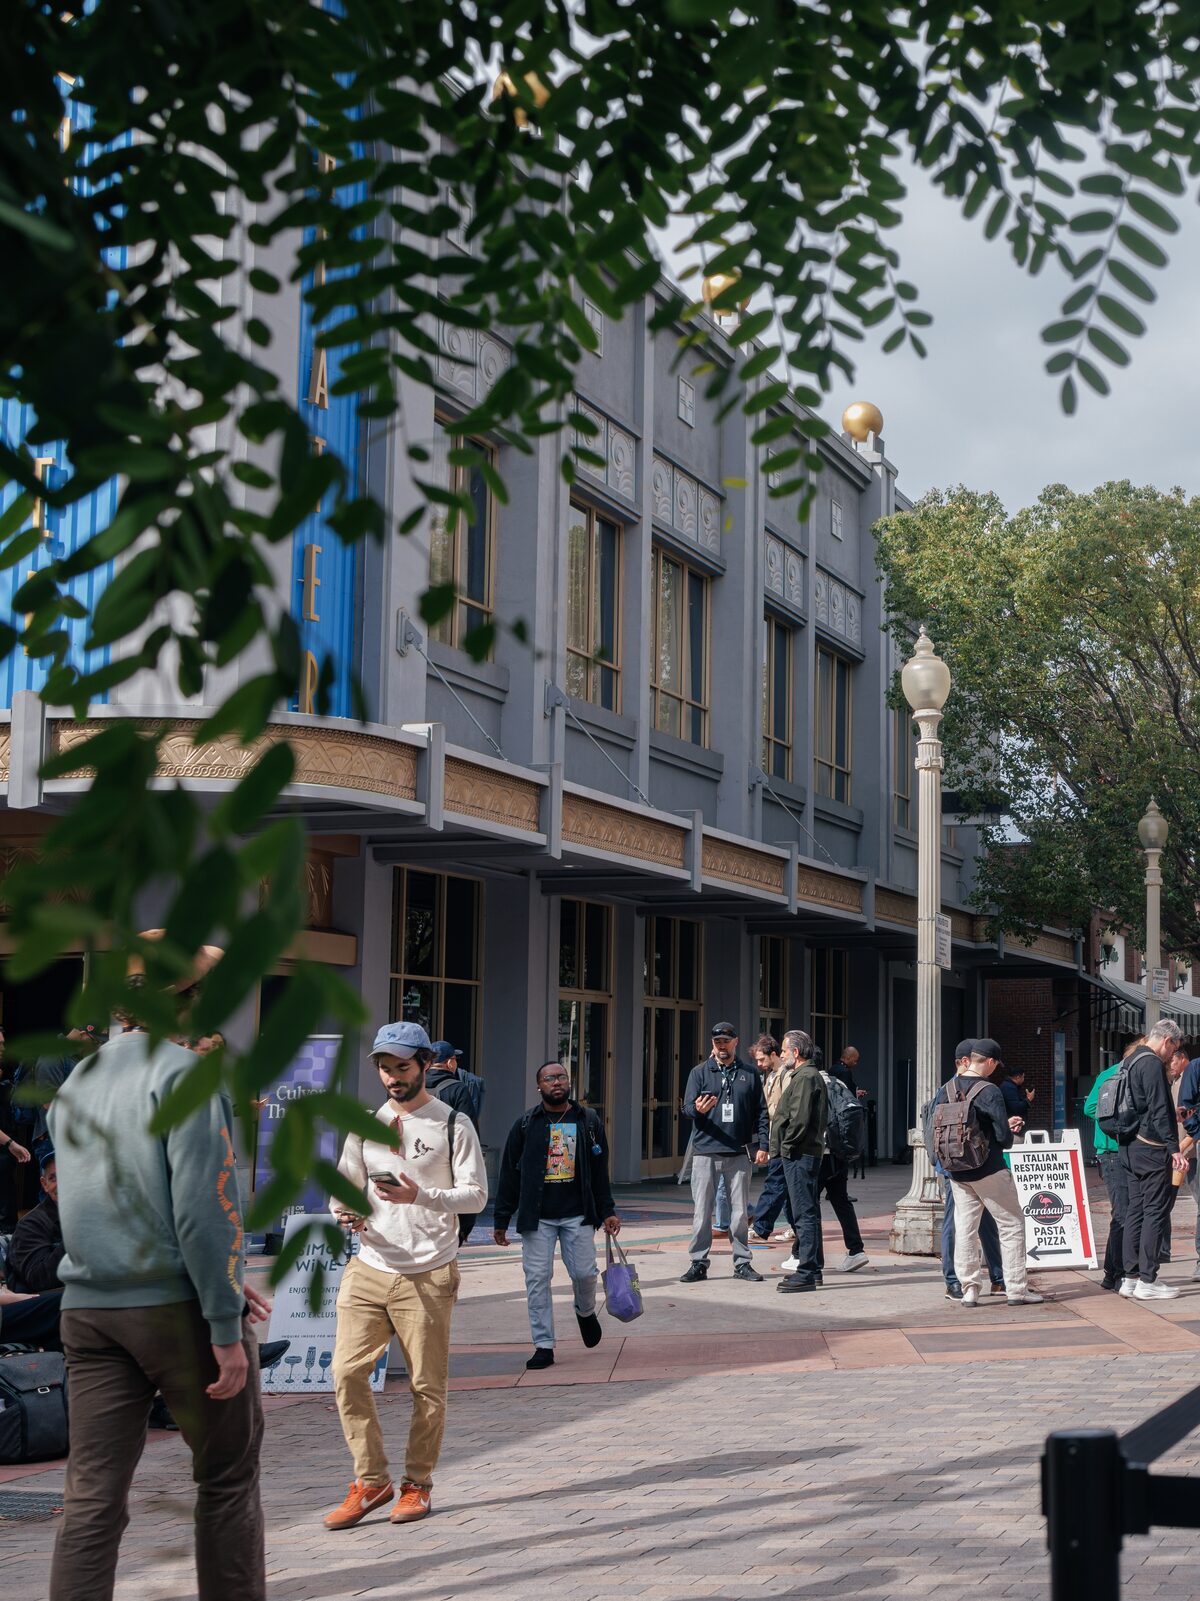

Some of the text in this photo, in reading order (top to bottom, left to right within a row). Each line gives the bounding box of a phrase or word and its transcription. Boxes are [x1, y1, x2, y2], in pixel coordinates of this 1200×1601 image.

[1023, 1153, 1058, 1163] ITALIAN
[1014, 1162, 1070, 1173] RESTAURANT
[1016, 1172, 1070, 1183] HAPPY HOUR
[1030, 1183, 1042, 1191] PM
[1055, 1182, 1066, 1190] PM
[1023, 1205, 1064, 1217] Carasau
[1034, 1226, 1066, 1236] PASTA
[1037, 1236, 1067, 1246] PIZZA
[290, 1311, 337, 1319] AND EXCLUSI
